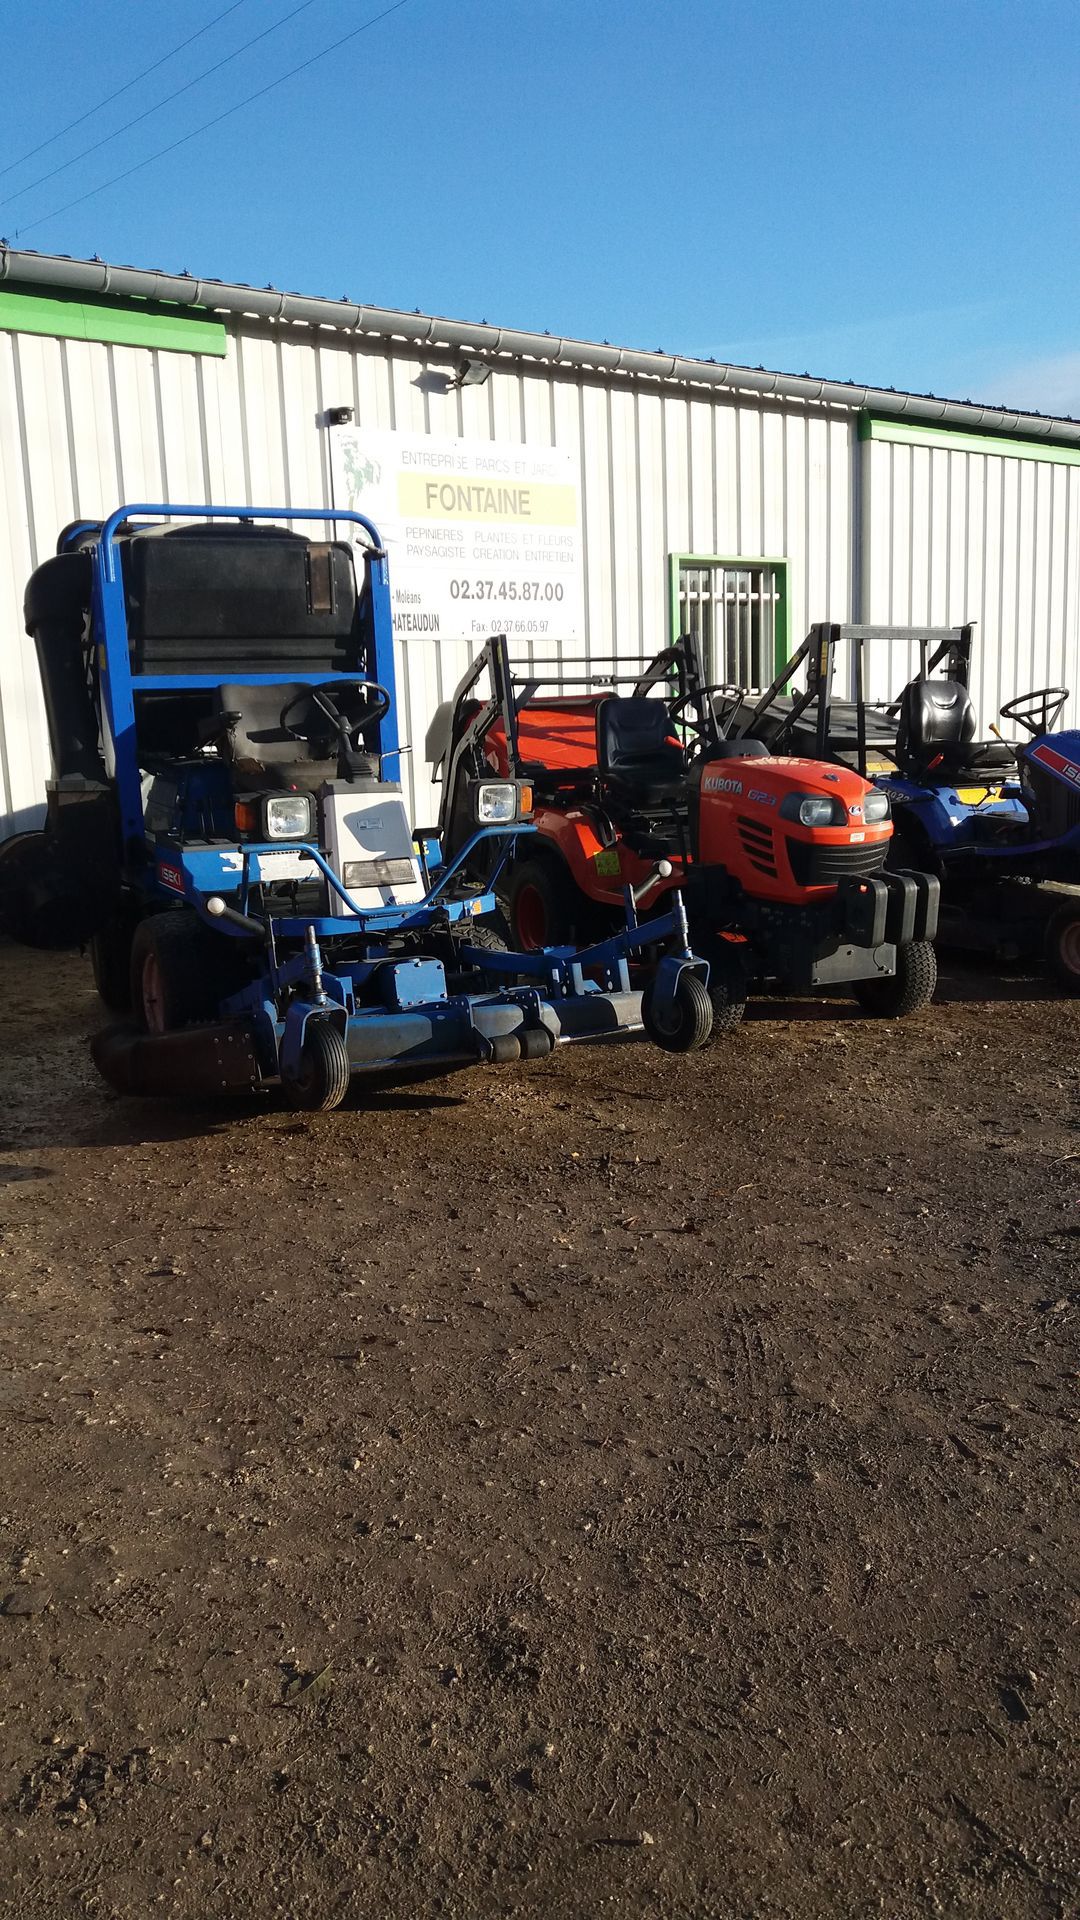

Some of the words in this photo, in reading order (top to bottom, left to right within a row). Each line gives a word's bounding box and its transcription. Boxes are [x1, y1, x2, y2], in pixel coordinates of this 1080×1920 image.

[402, 450, 468, 470] ENTREPRISE
[475, 457, 510, 474] PARCS
[515, 461, 526, 474] ET
[425, 482, 531, 515] FONTAINE
[405, 526, 464, 541] PEPINIERES
[474, 530, 517, 544] PLANTES
[523, 533, 534, 545] ET
[538, 534, 574, 547] FLEURS
[407, 543, 467, 559] PAYSAGISTE
[472, 547, 519, 560] CREATION
[525, 550, 574, 562] ENTRETIEN
[450, 579, 564, 601] 02.37.45.87.00
[392, 613, 440, 632] HATEAUDUN
[471, 620, 488, 632] Fax:
[491, 620, 549, 633] 02.37.66.05.97
[704, 777, 743, 794] KUBOTA
[162, 867, 181, 886] ISEKI
